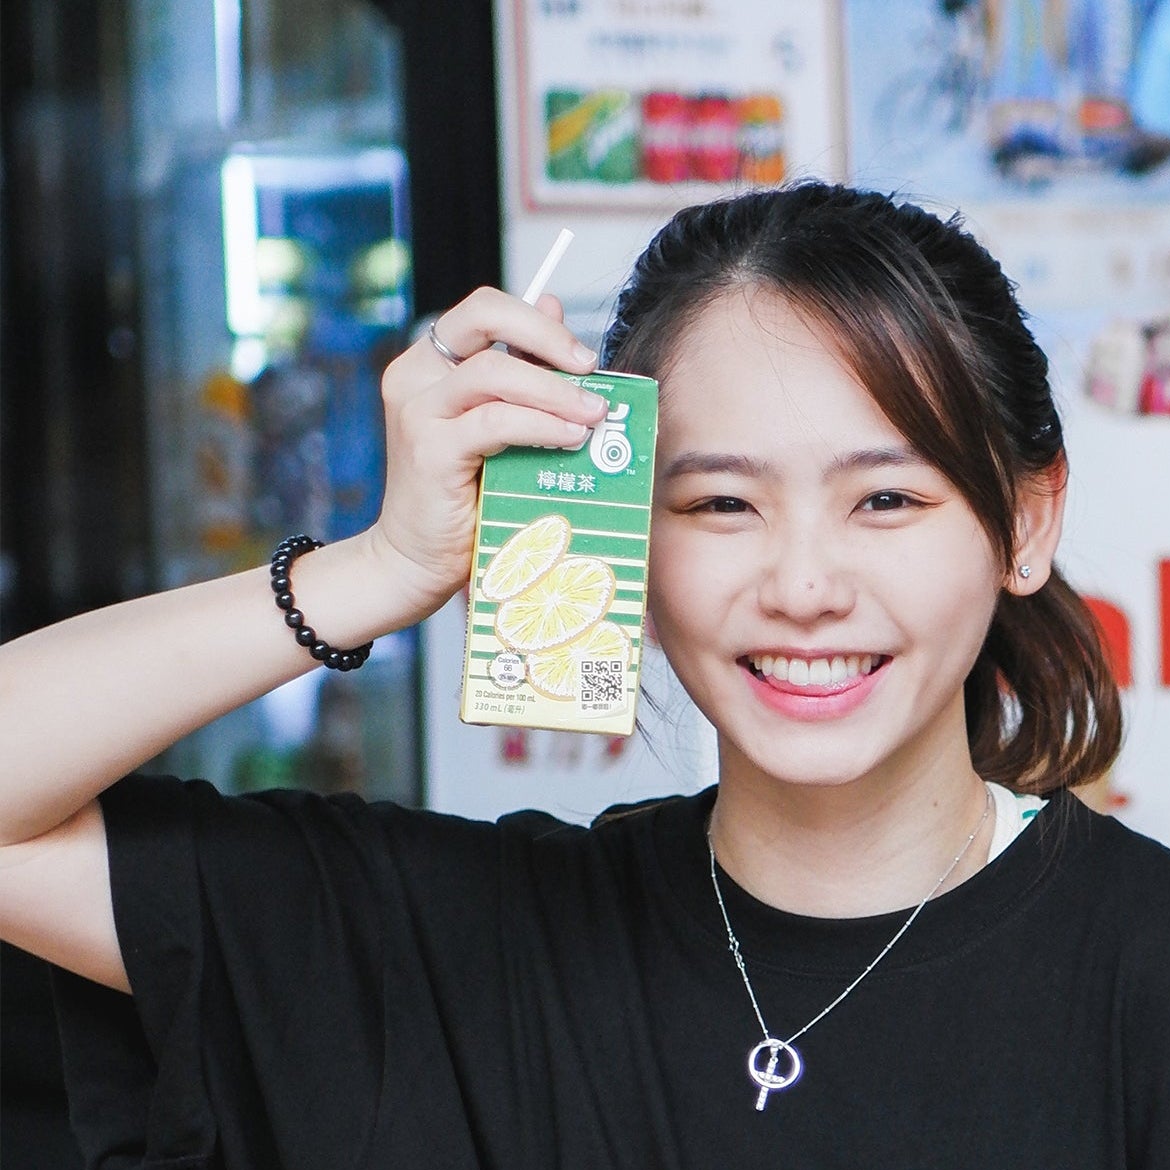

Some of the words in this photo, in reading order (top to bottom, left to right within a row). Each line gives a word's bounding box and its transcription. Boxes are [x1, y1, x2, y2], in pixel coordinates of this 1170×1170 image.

[536, 470, 596, 493] 檸檬茶
[483, 691, 505, 699] Calories
[474, 702, 489, 711] 330
